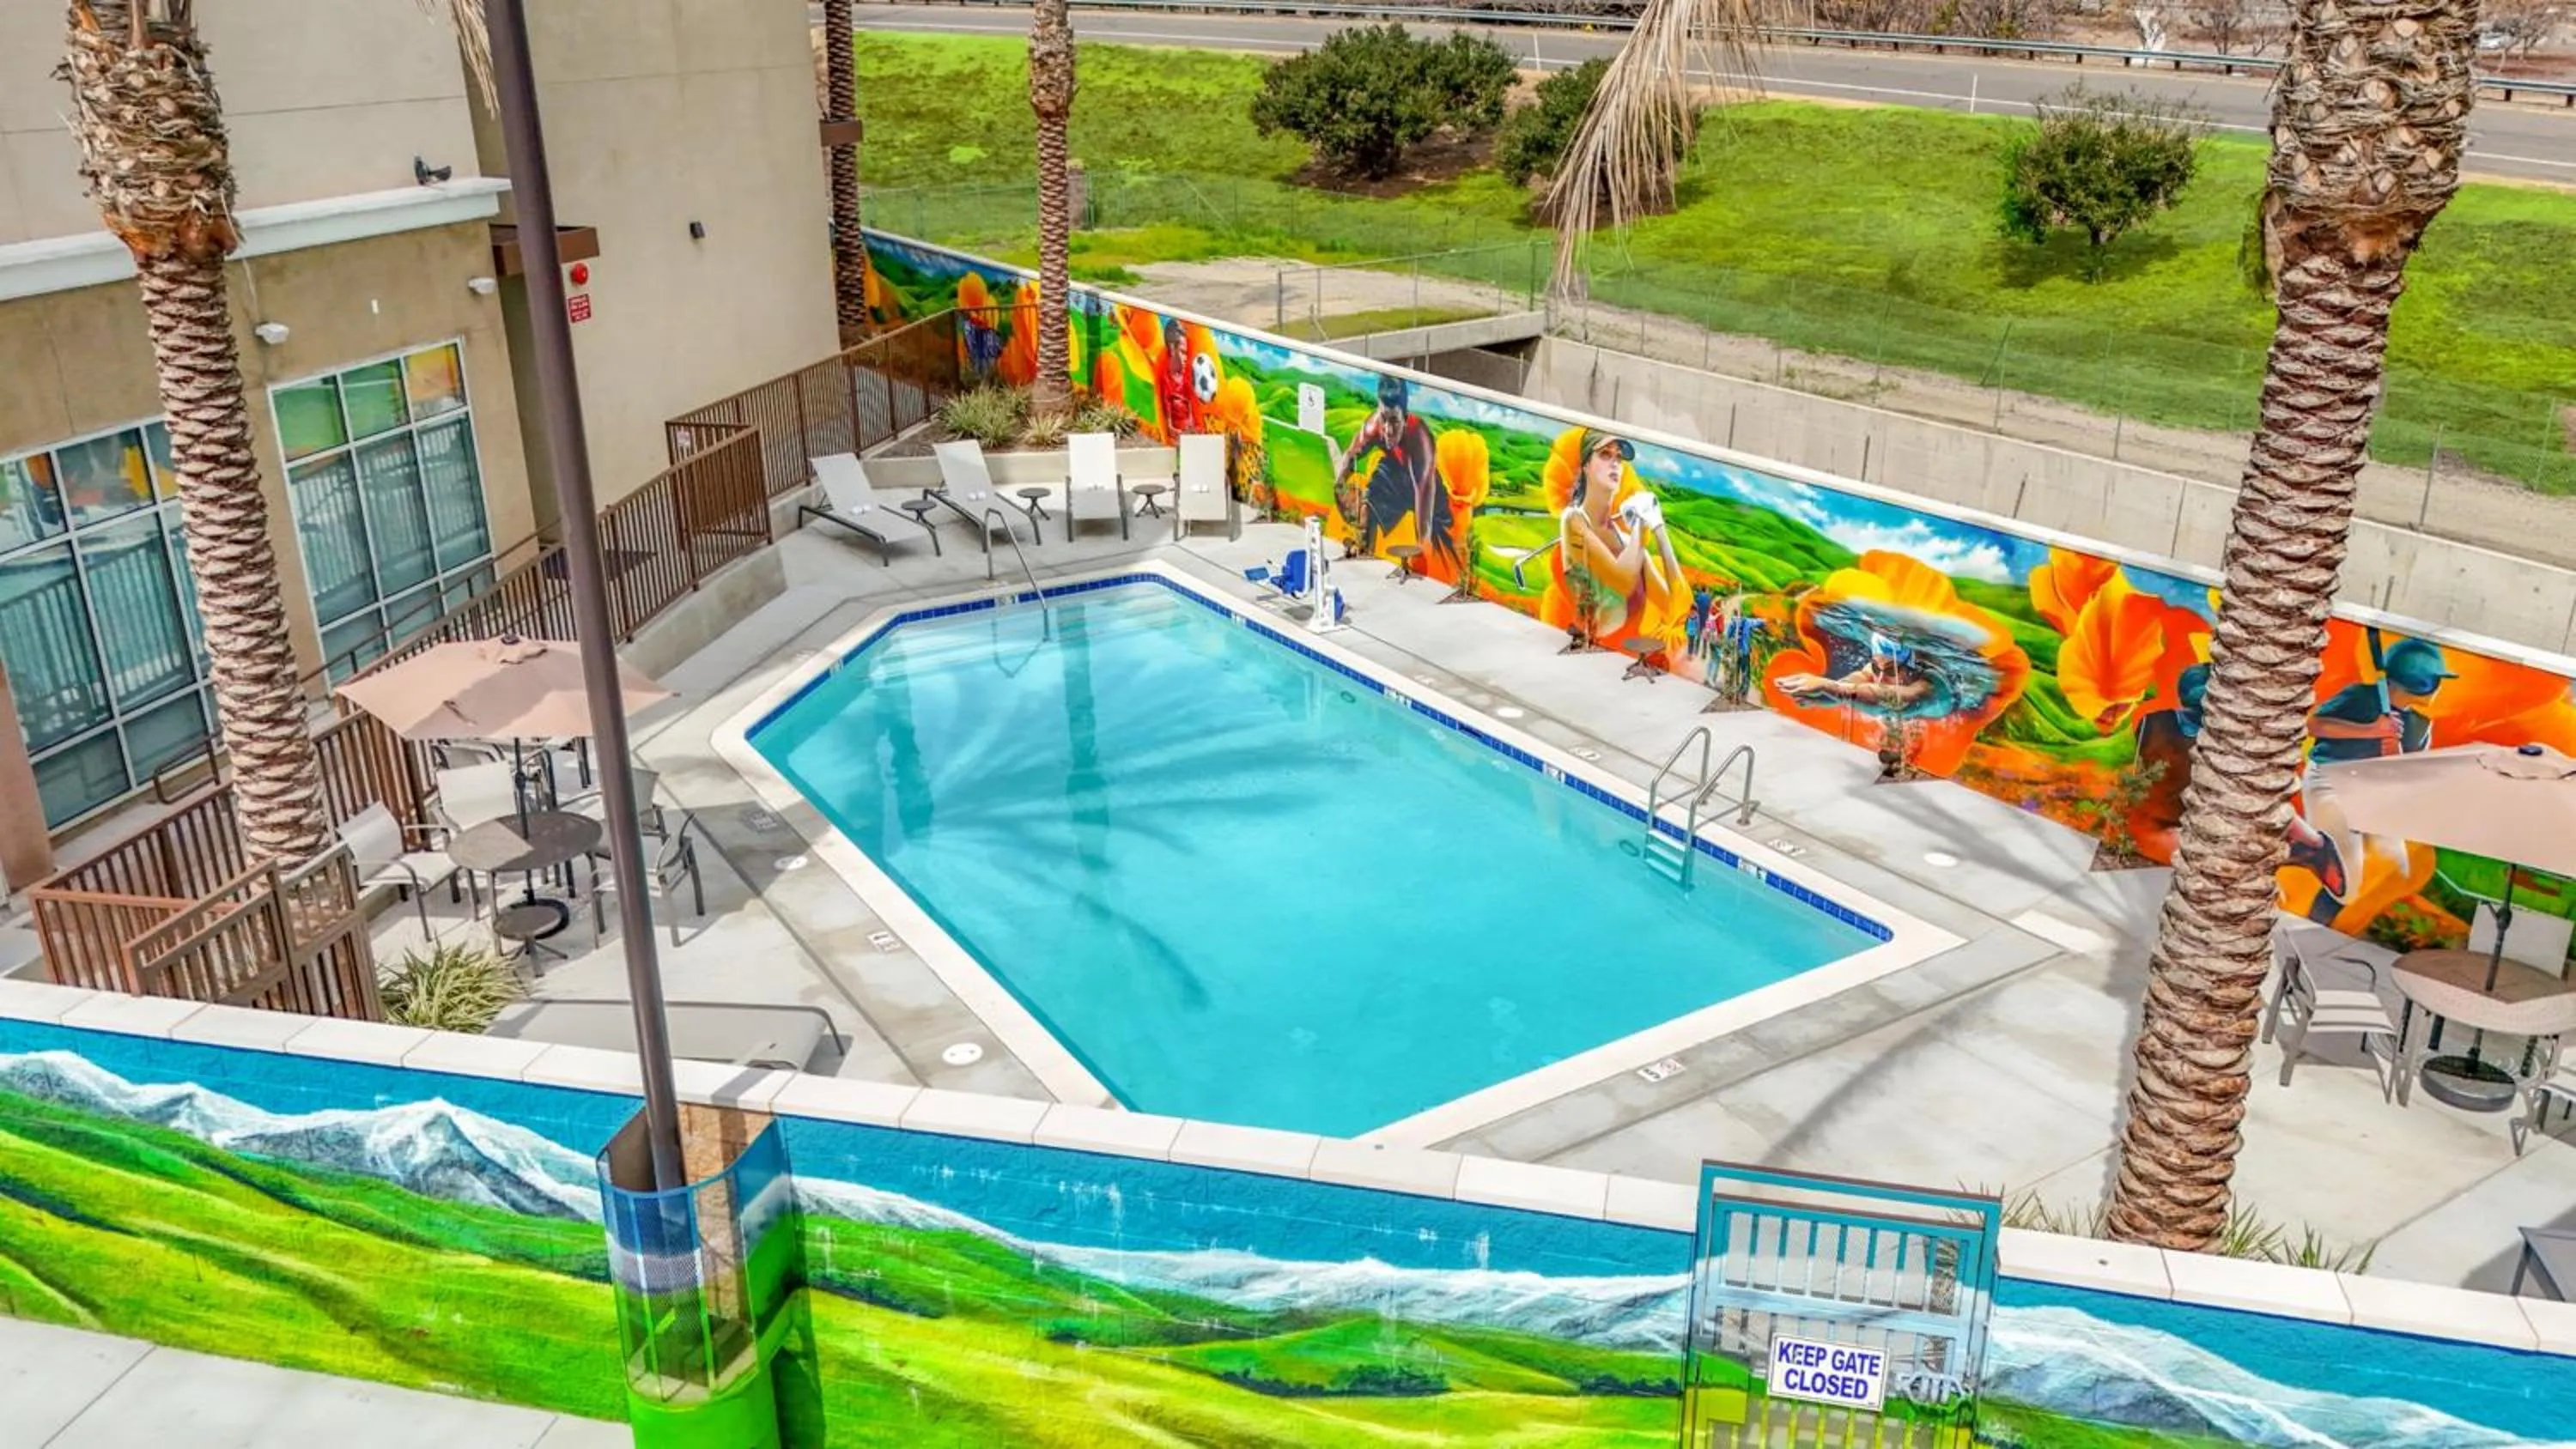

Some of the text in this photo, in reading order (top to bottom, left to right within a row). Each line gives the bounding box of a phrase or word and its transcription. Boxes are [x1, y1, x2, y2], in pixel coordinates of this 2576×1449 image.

[1777, 1341, 1881, 1376] KEEP GATE
[1784, 1368, 1868, 1399] CLOSED
